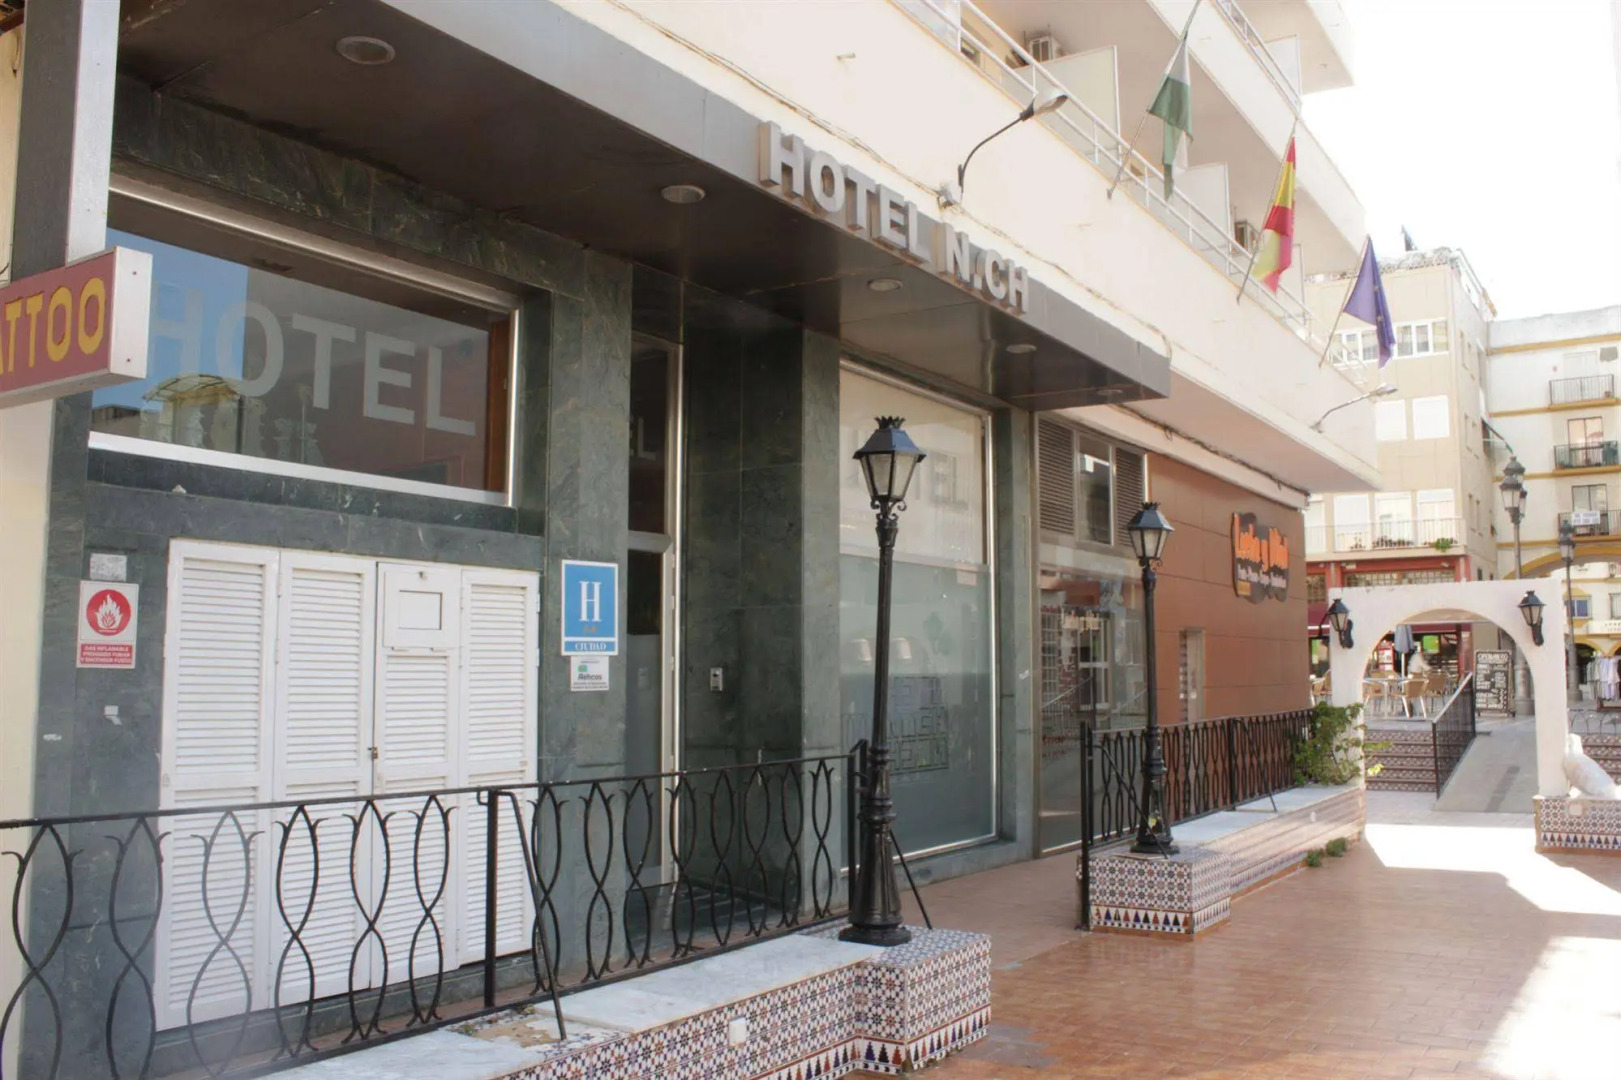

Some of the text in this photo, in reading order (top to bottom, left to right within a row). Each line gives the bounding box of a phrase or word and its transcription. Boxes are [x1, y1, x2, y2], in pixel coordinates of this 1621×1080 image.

[758, 121, 1029, 315] HOTEL N.CH
[0, 277, 105, 375] TTOO
[149, 281, 476, 437] HOTEL
[574, 641, 607, 651] CIUDAD
[579, 581, 602, 622] H
